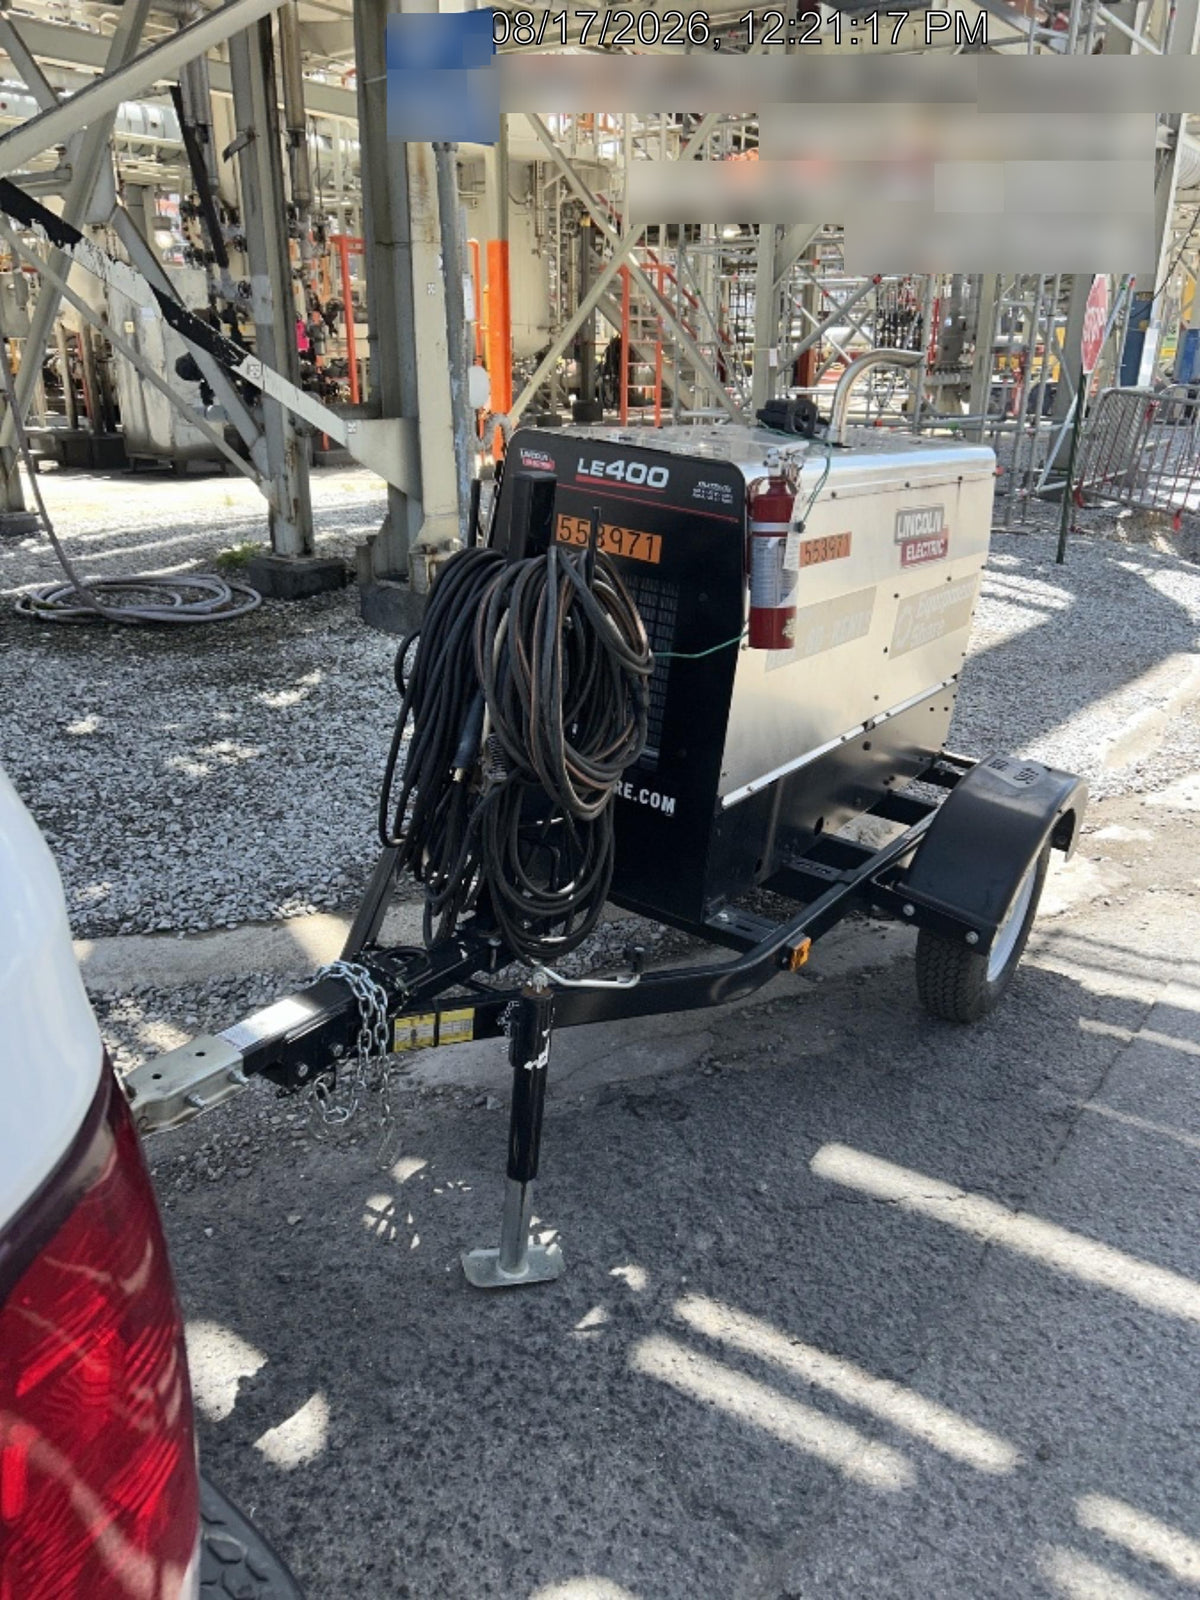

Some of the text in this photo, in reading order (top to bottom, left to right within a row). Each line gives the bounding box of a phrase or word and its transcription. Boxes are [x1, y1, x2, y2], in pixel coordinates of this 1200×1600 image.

[577, 457, 670, 489] LE400
[896, 504, 944, 539] LINCOLN
[905, 537, 946, 561] ELECTRIC
